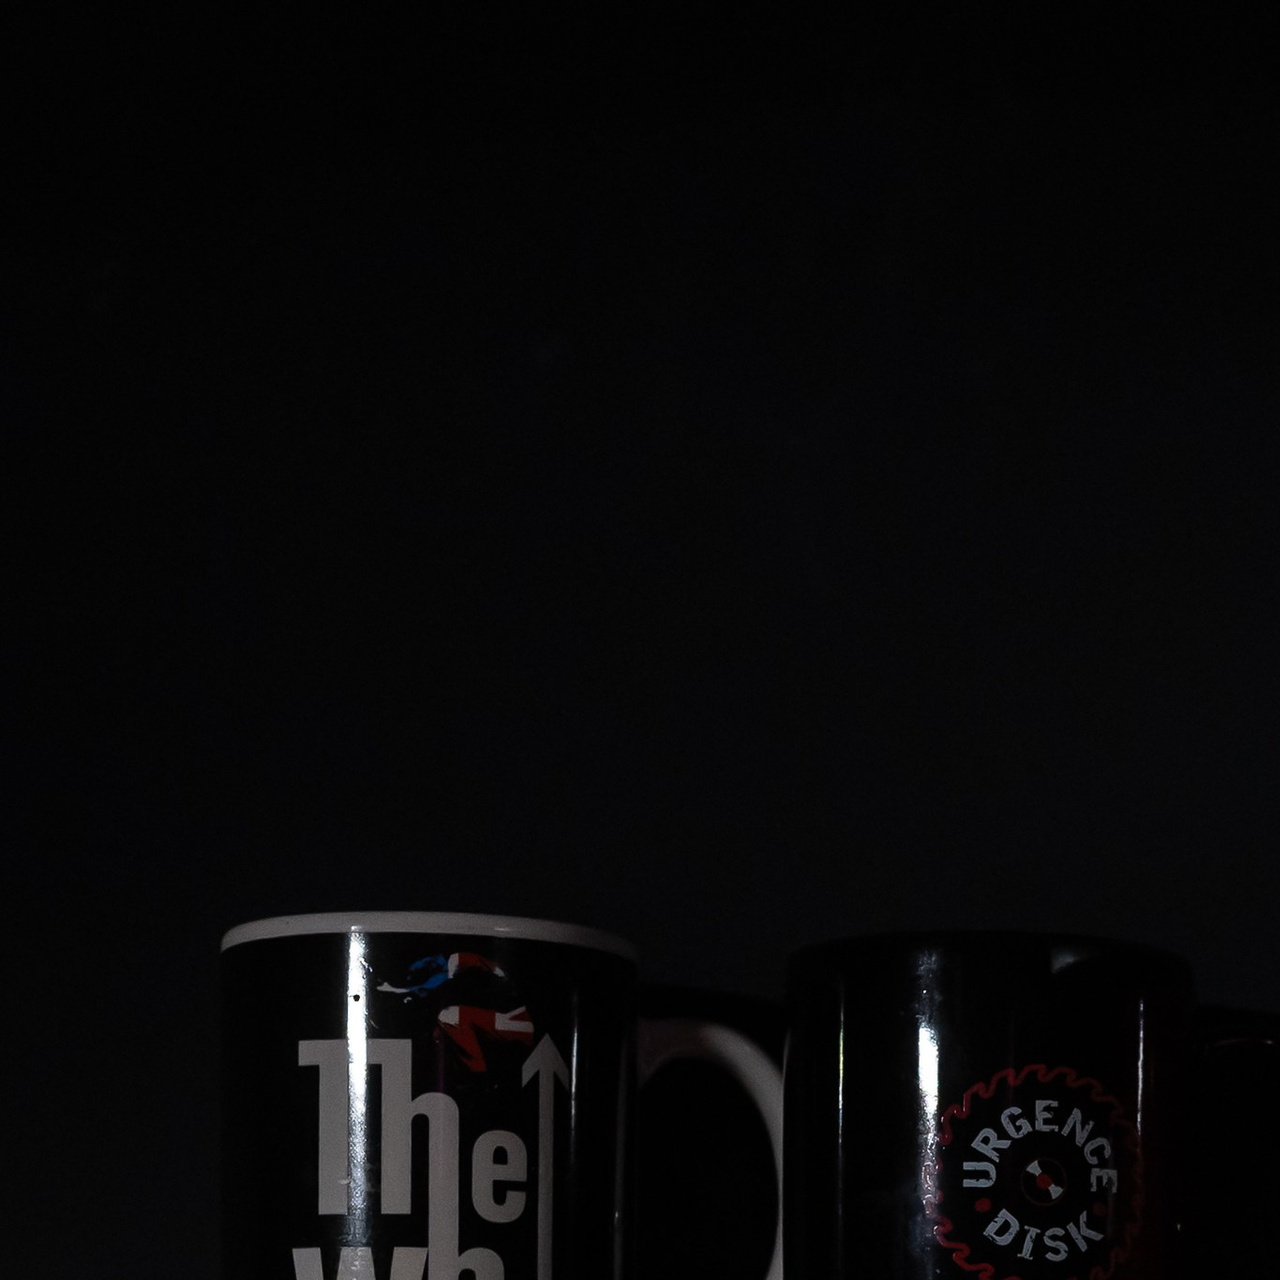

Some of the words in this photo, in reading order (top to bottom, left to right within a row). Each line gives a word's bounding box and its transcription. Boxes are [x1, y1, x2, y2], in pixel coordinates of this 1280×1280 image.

[298, 1038, 528, 1223] The
[962, 1099, 1118, 1193] URGENCE
[983, 1208, 1104, 1263] DISK
